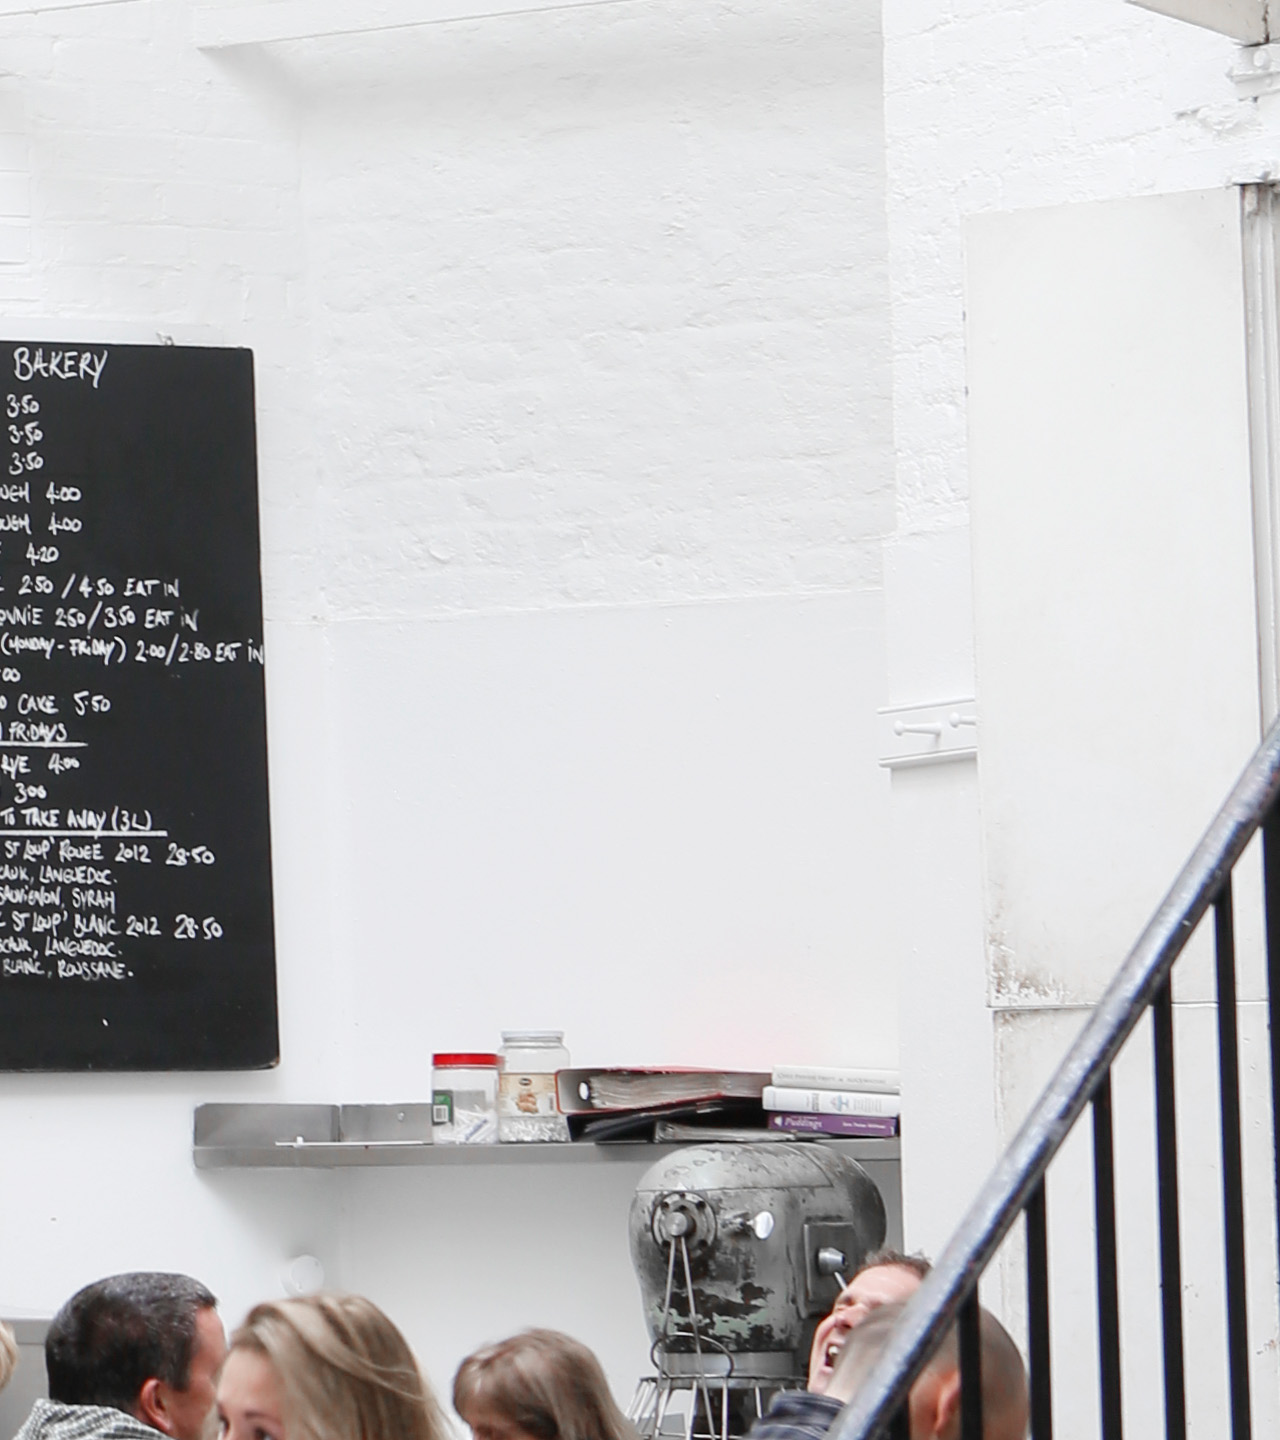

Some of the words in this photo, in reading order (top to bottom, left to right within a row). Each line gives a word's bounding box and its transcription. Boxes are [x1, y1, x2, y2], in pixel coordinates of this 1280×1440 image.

[13, 346, 109, 389] BAKERY
[123, 577, 160, 598] EAT
[163, 577, 180, 598] IN
[143, 607, 175, 630] EAT
[214, 641, 242, 663] EAT
[17, 693, 59, 715] CAKE
[8, 718, 69, 743] FRIDAYS
[20, 806, 60, 828] TAKE
[114, 842, 152, 863] 2012
[72, 887, 116, 915] SYRAH
[73, 913, 121, 938] BLANC
[125, 915, 162, 938] 2012
